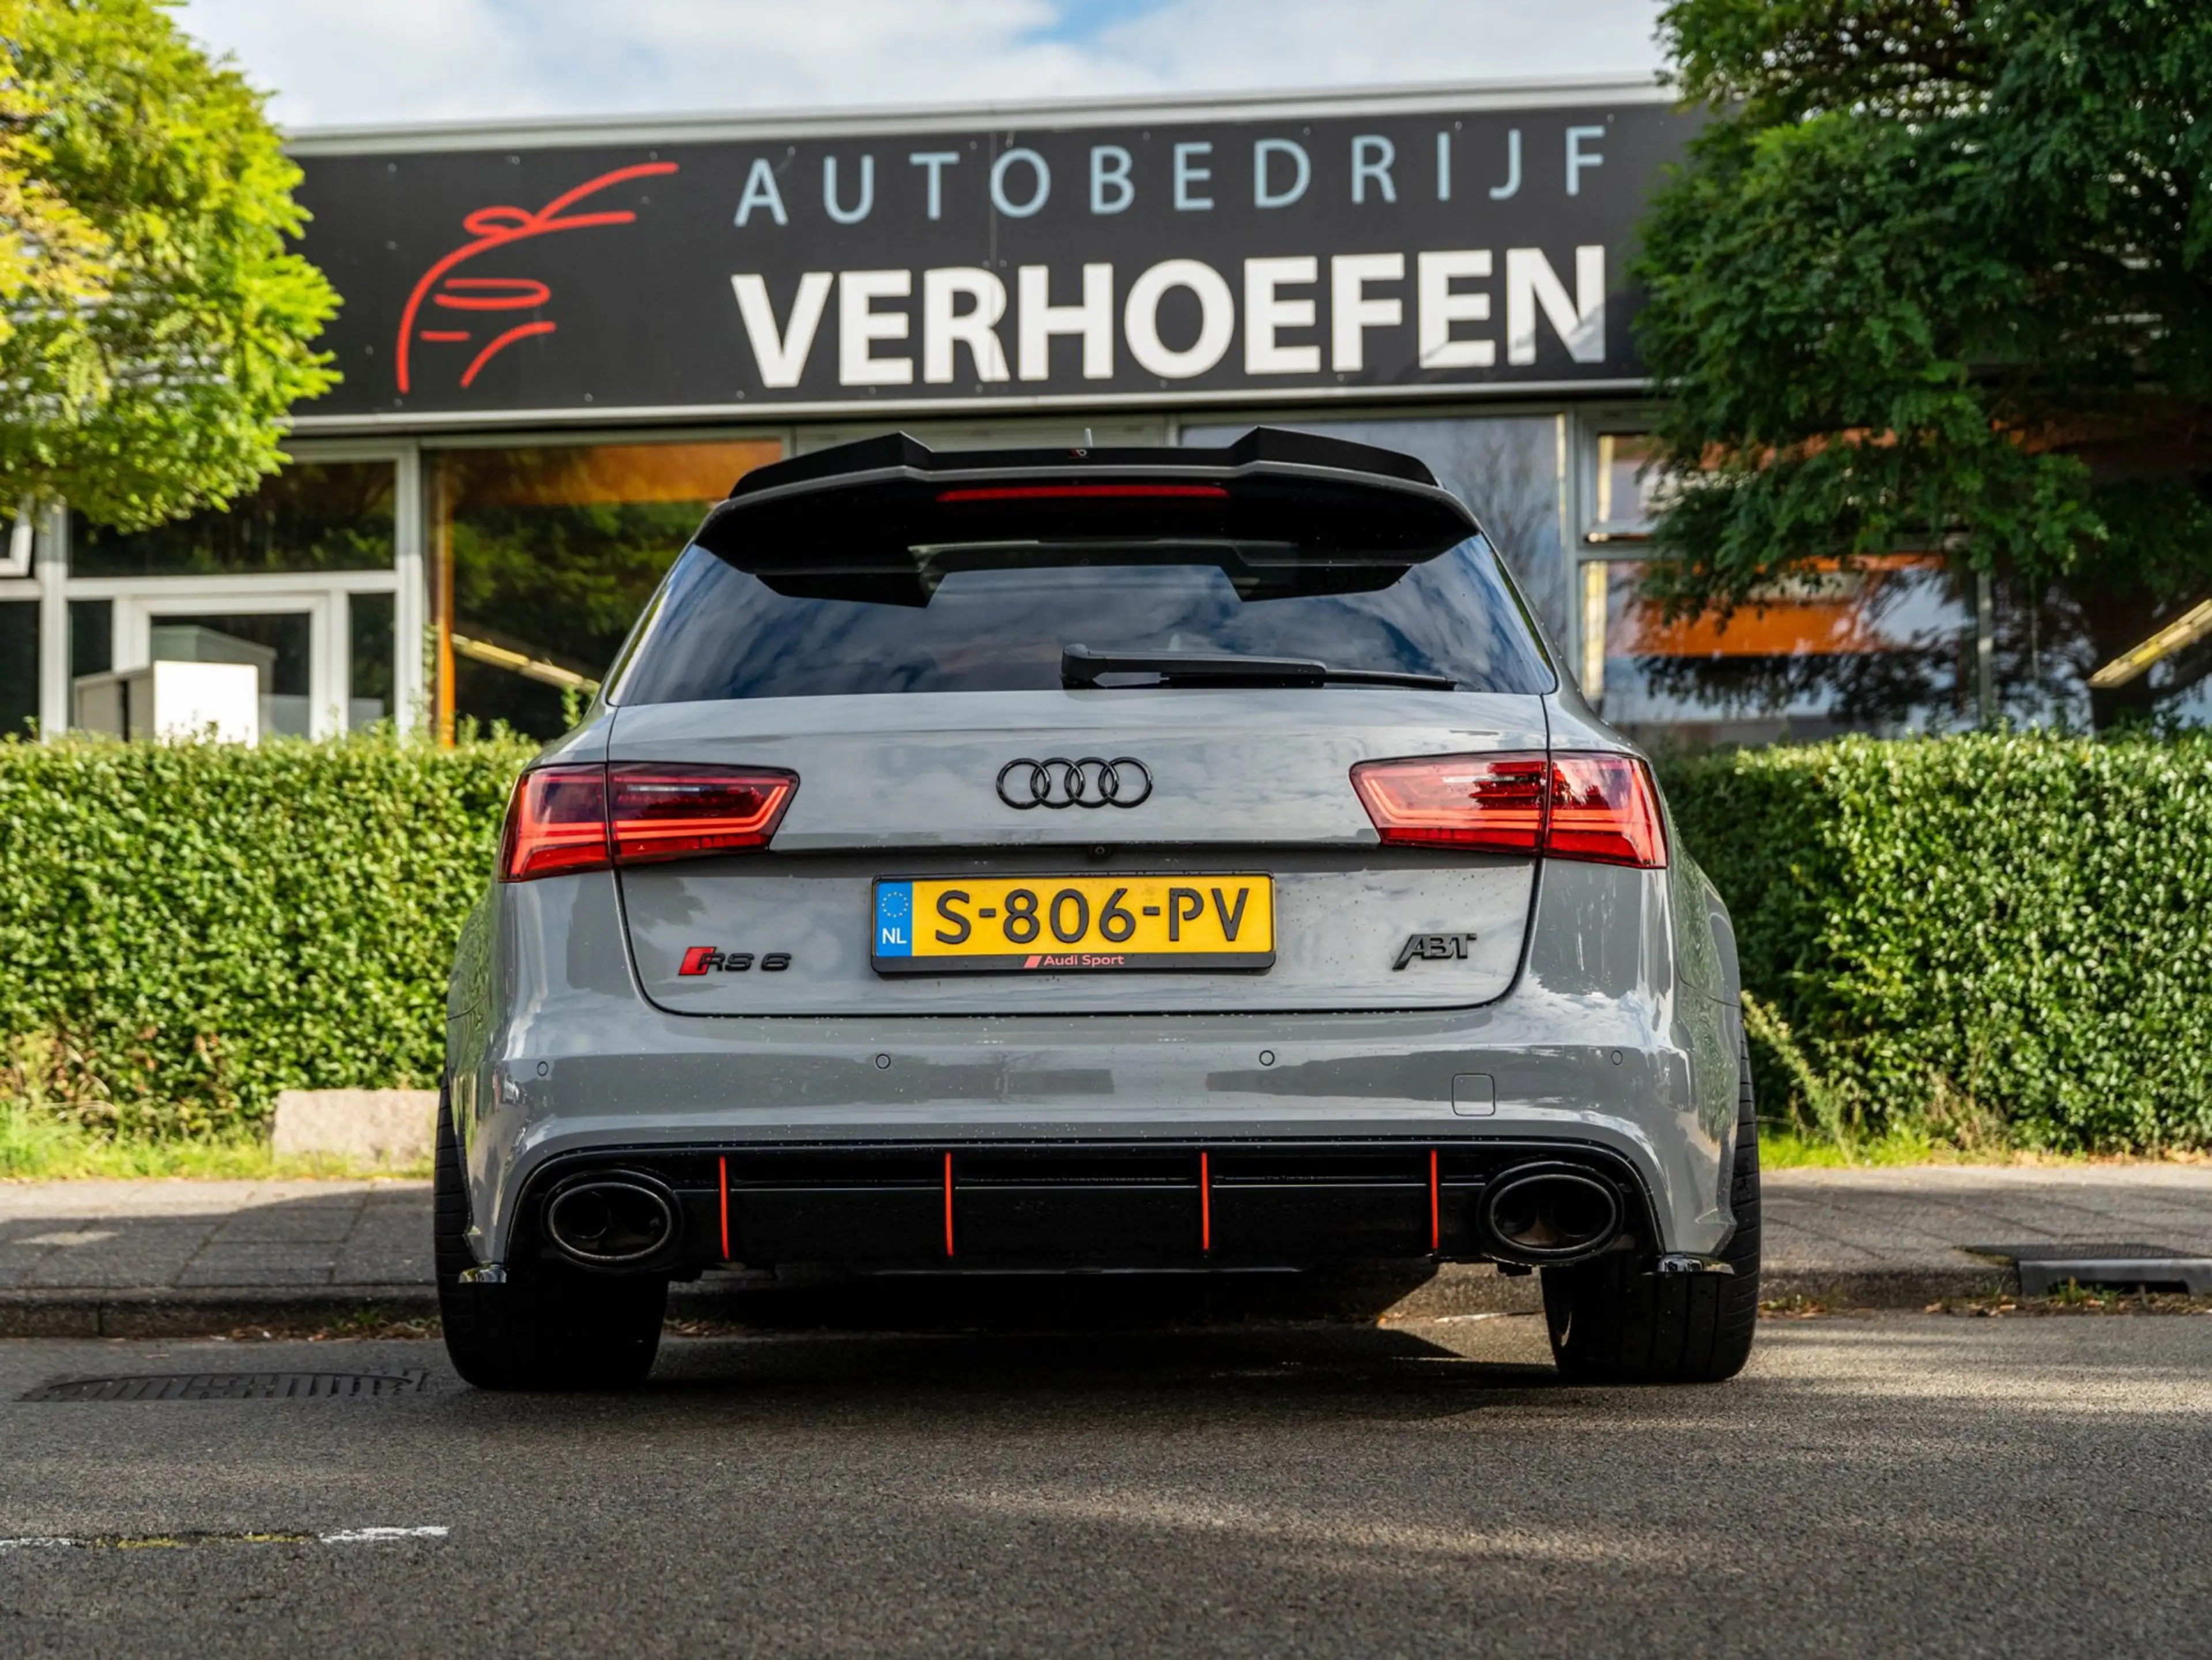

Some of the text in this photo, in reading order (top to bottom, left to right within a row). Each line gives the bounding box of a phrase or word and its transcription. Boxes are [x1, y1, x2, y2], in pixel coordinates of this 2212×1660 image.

[734, 126, 1606, 227] AUTOBEDRIJF
[730, 245, 1606, 388] VERHOEFEN
[882, 927, 908, 945] NL
[935, 888, 1250, 944] S-806-PV
[1044, 954, 1124, 967] Audi Sport
[1392, 933, 1477, 970] ABT
